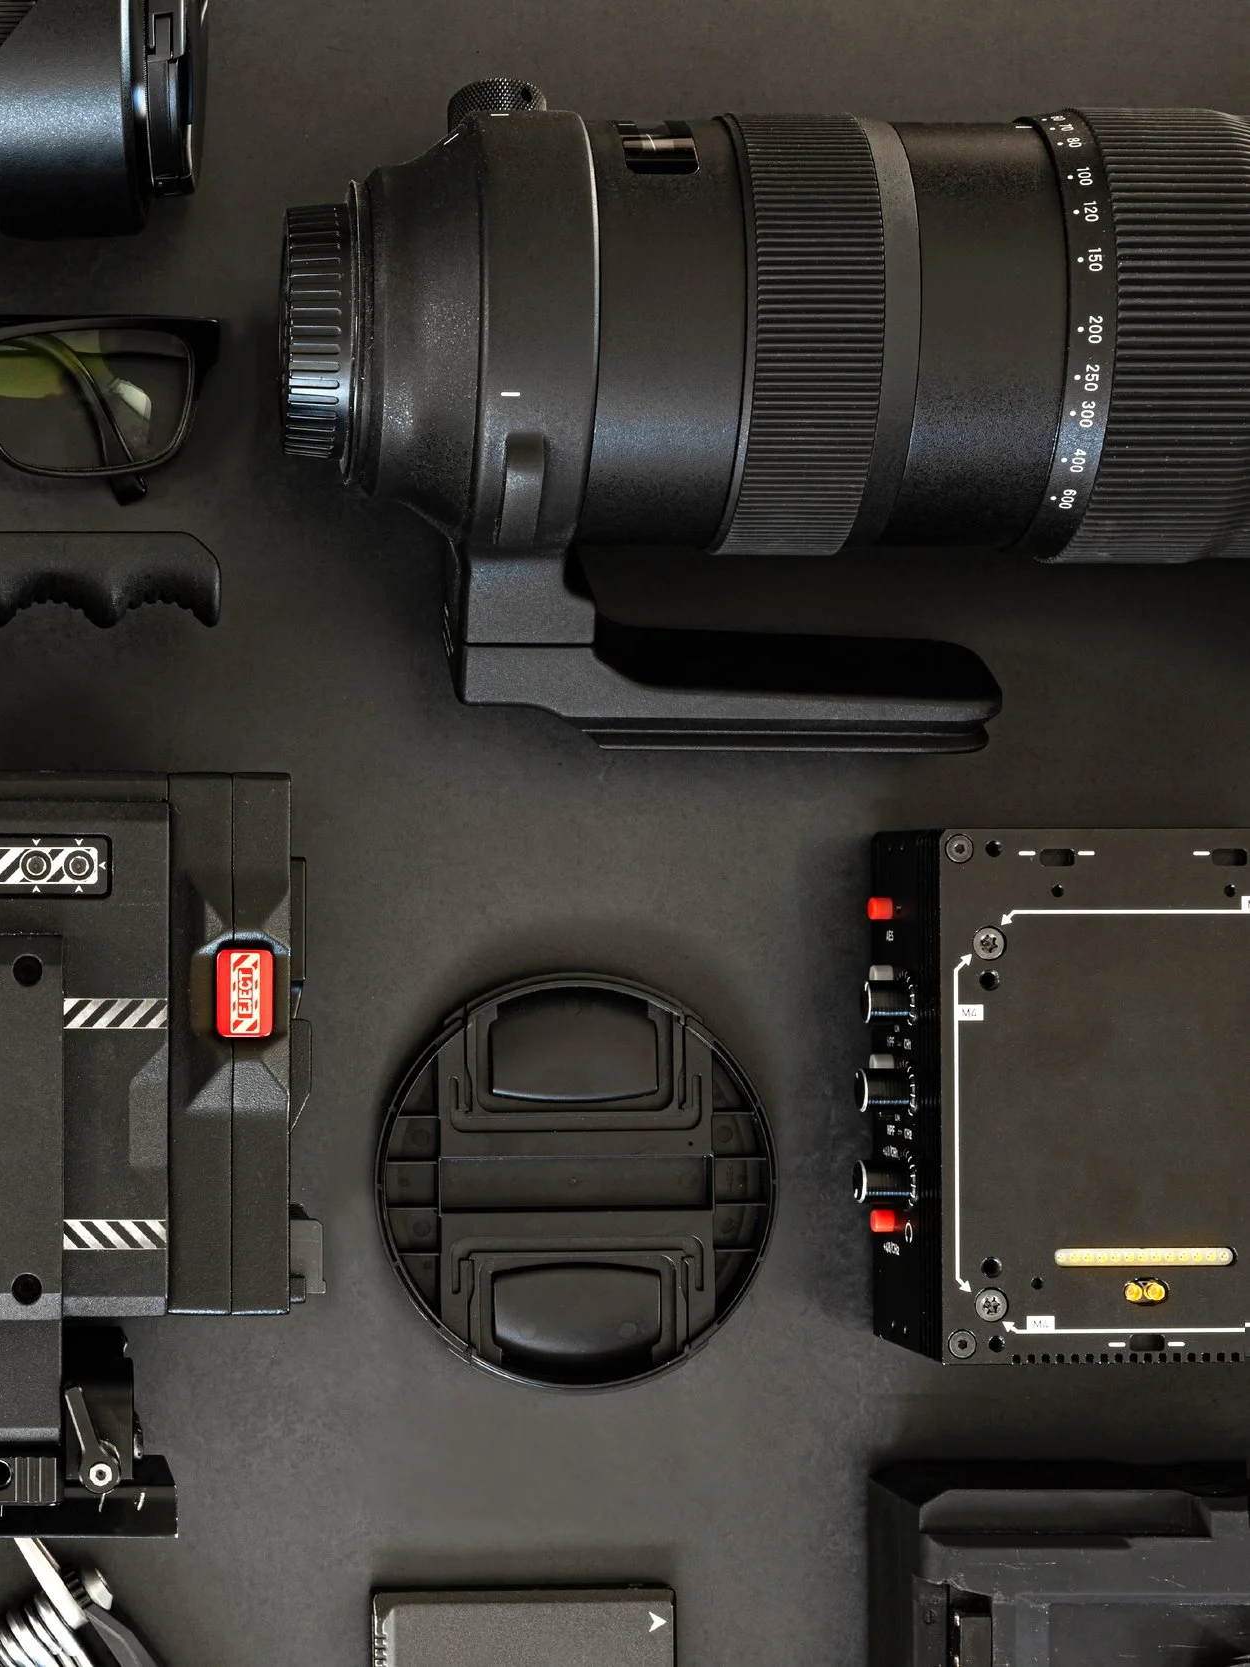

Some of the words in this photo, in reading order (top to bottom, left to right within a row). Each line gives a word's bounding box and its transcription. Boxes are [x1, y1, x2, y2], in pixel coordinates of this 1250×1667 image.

[1067, 138, 1082, 147] 80
[1077, 167, 1093, 185] 100
[1084, 201, 1099, 222] 120
[1089, 248, 1103, 271] 150
[1088, 316, 1103, 343] 200
[1084, 364, 1100, 391] 250
[1079, 401, 1096, 428] 300
[1070, 448, 1086, 472] 400
[1059, 489, 1077, 509] 600
[238, 970, 252, 1014] EJECT
